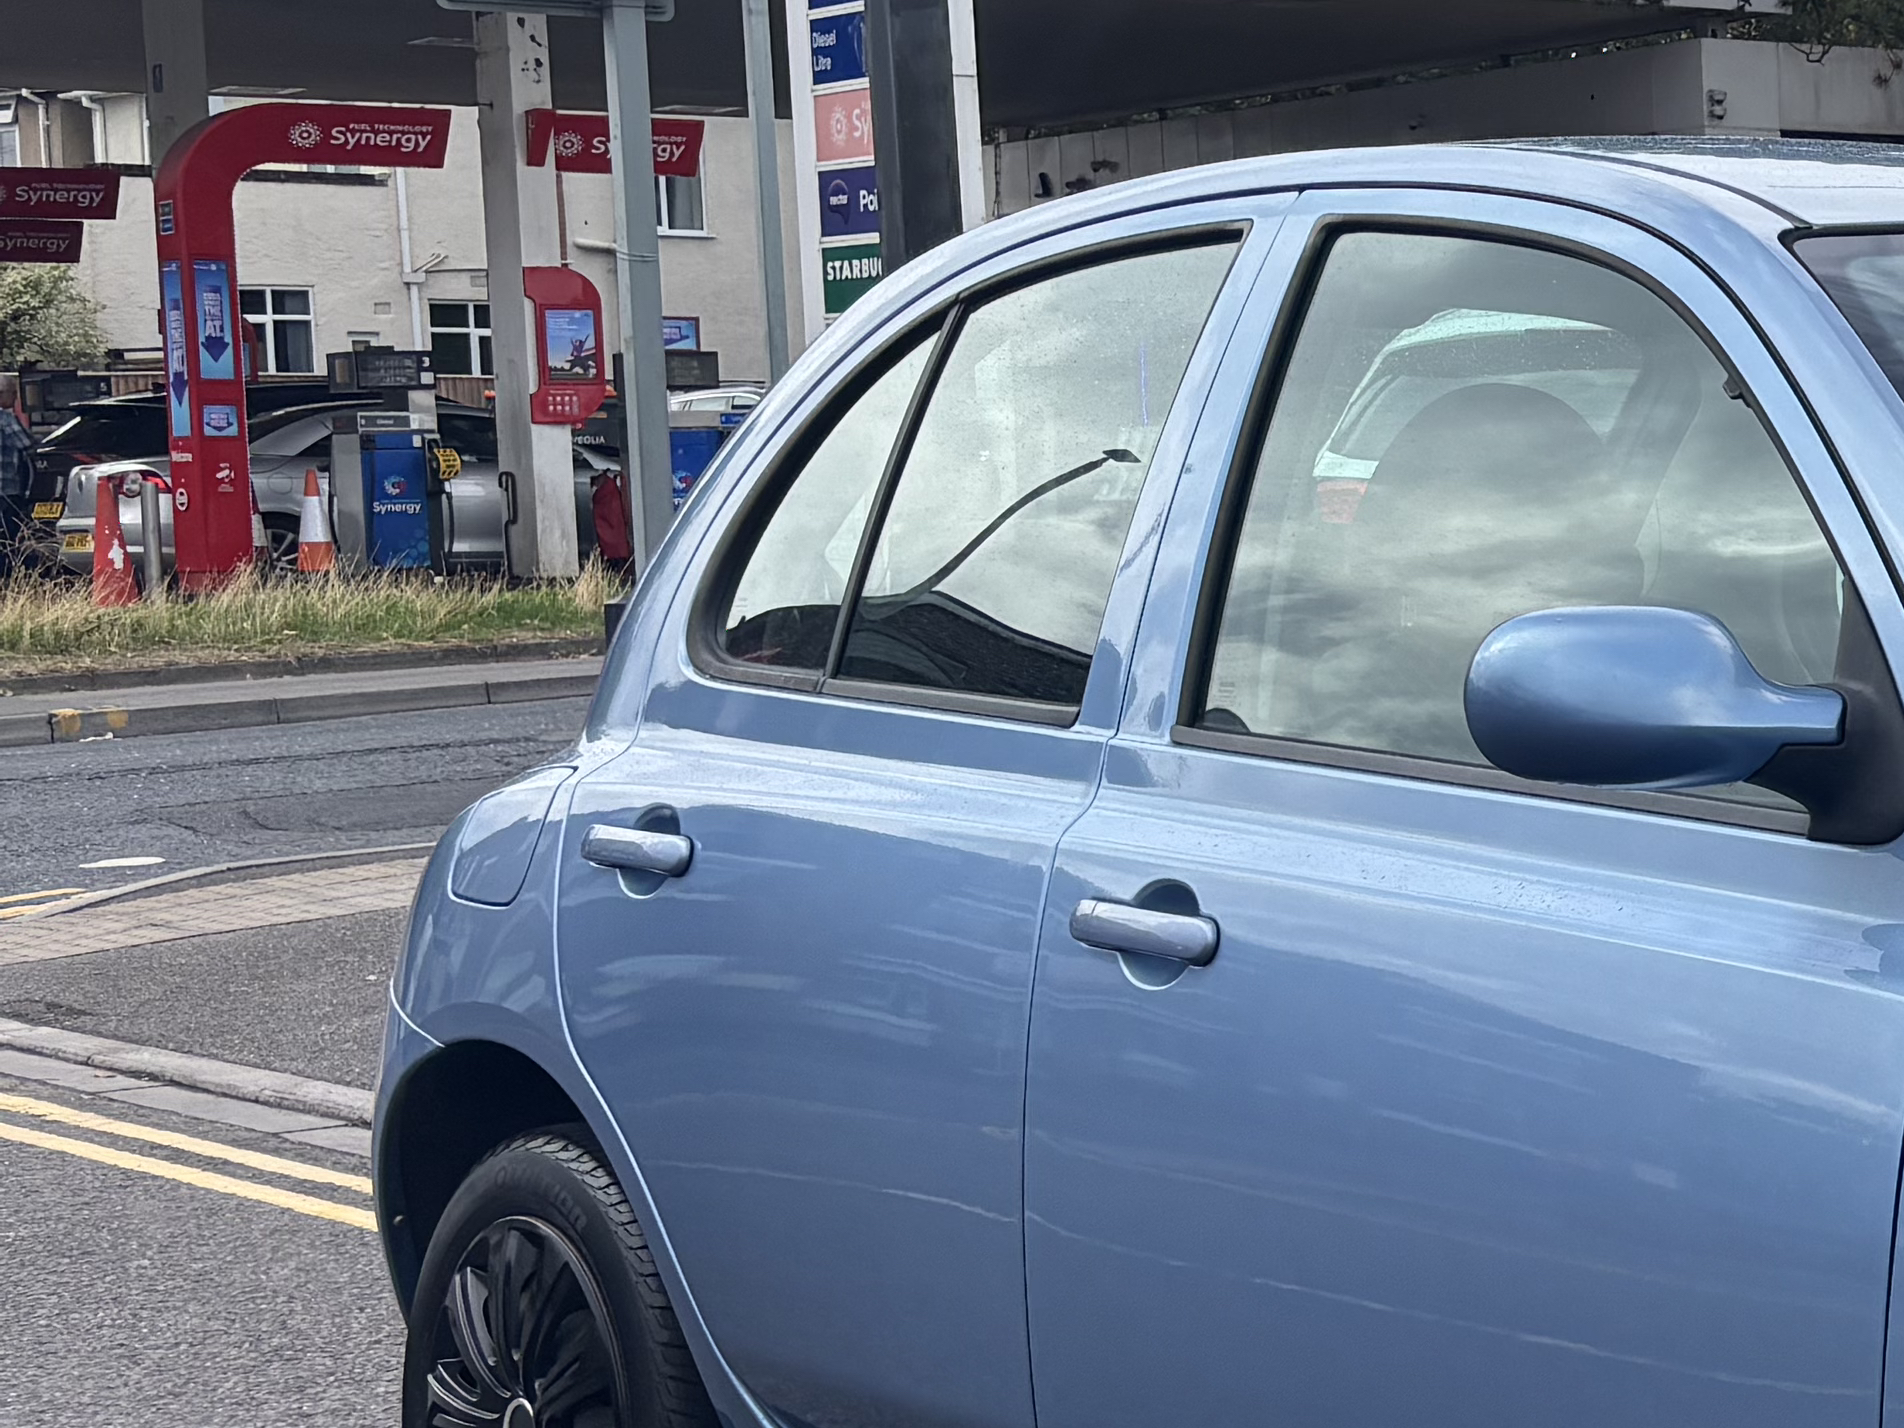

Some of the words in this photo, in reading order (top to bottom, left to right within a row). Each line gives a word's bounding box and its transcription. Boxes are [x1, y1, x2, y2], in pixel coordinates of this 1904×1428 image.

[812, 30, 836, 48] Diesel
[330, 127, 432, 152] Synergy
[15, 186, 105, 207] Synergy
[826, 257, 882, 281] STARBU
[421, 357, 430, 367] 3
[100, 382, 107, 391] 5
[372, 501, 422, 514] Synergy
